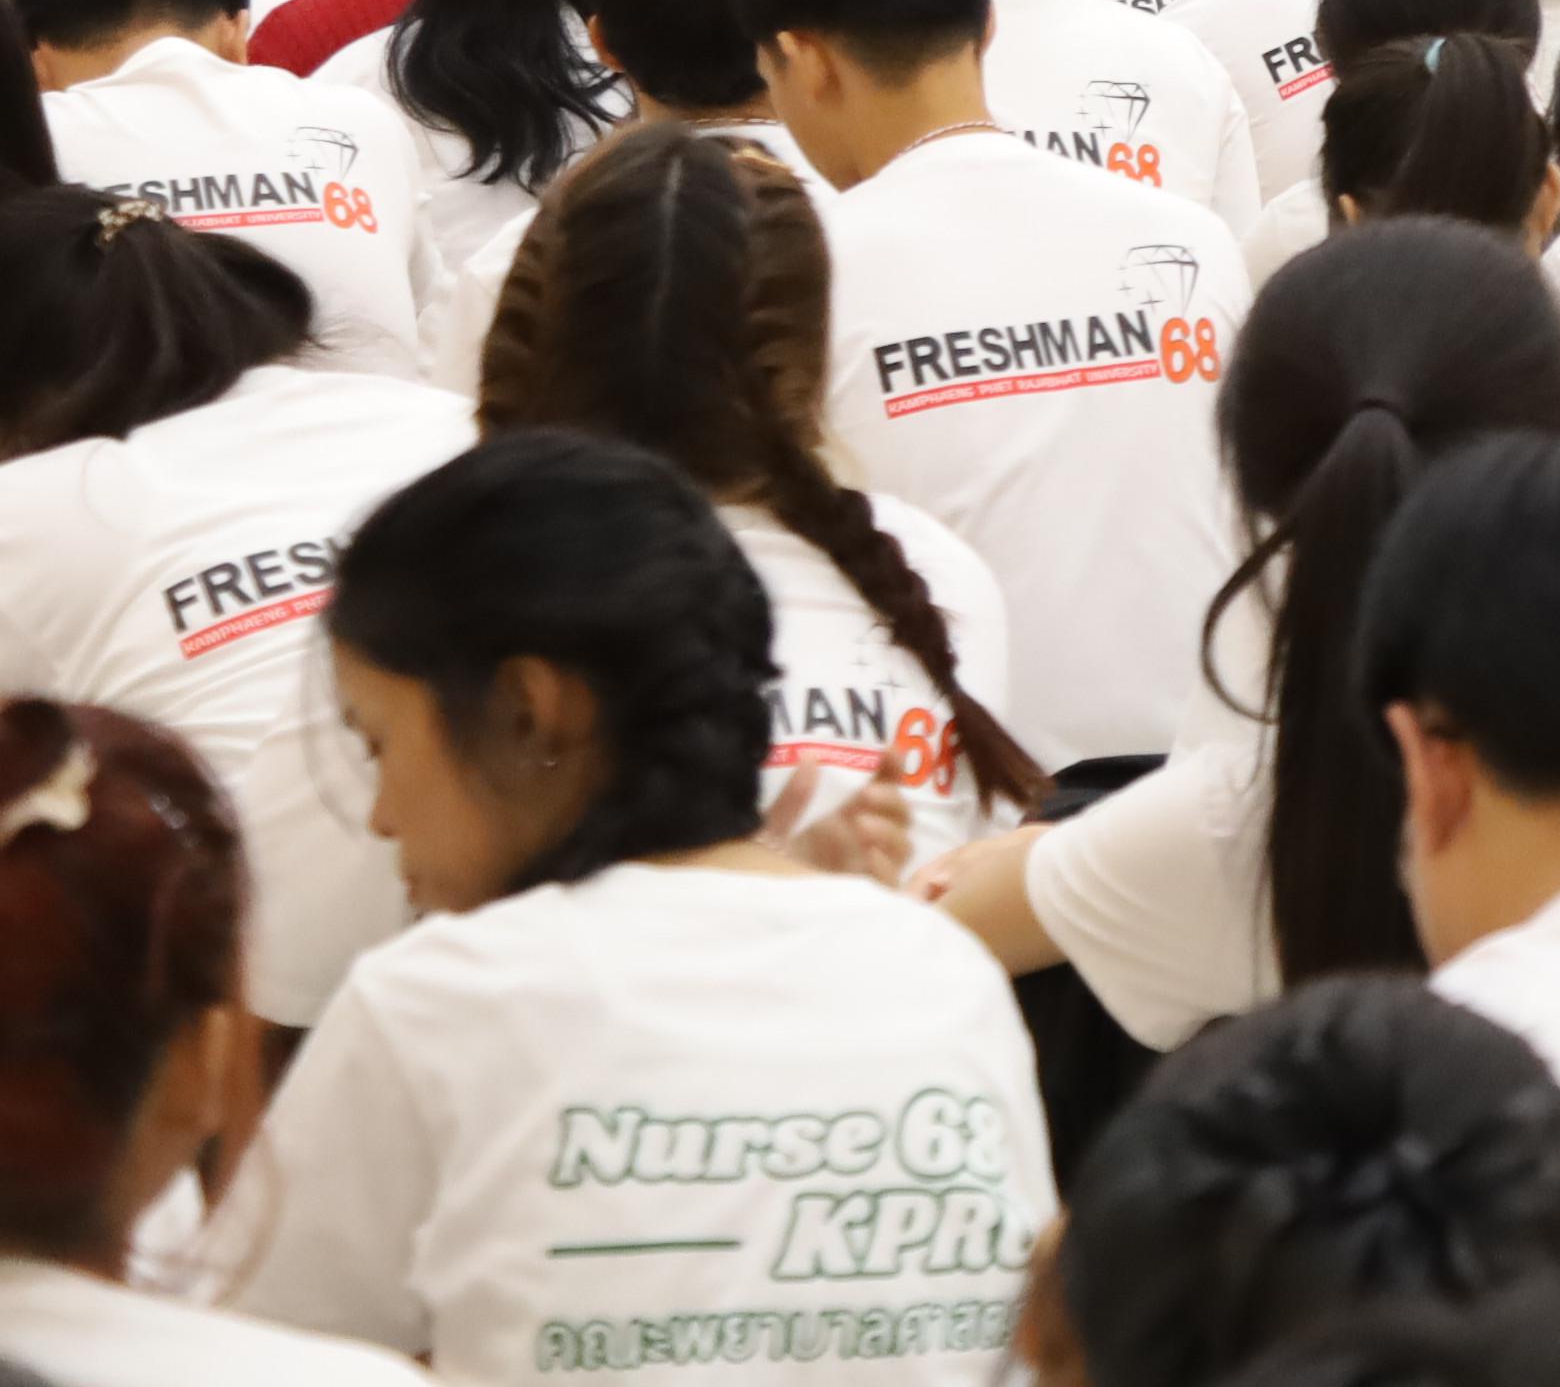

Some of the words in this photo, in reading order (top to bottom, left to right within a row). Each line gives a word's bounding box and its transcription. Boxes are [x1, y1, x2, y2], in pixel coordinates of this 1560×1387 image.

[1107, 141, 1162, 188] 68
[104, 172, 320, 212] SHMAN
[323, 181, 378, 234] 68
[178, 213, 242, 228] AJABHAT
[873, 310, 1155, 393] FRESHMAN
[1160, 317, 1221, 384] 68
[888, 386, 975, 415] KAMPHAENG
[979, 379, 1015, 398] PHET
[163, 537, 339, 632] FRES
[182, 605, 288, 654] KAMPHAENG
[548, 1106, 886, 1189] Nurse
[899, 1087, 1006, 1182] 68
